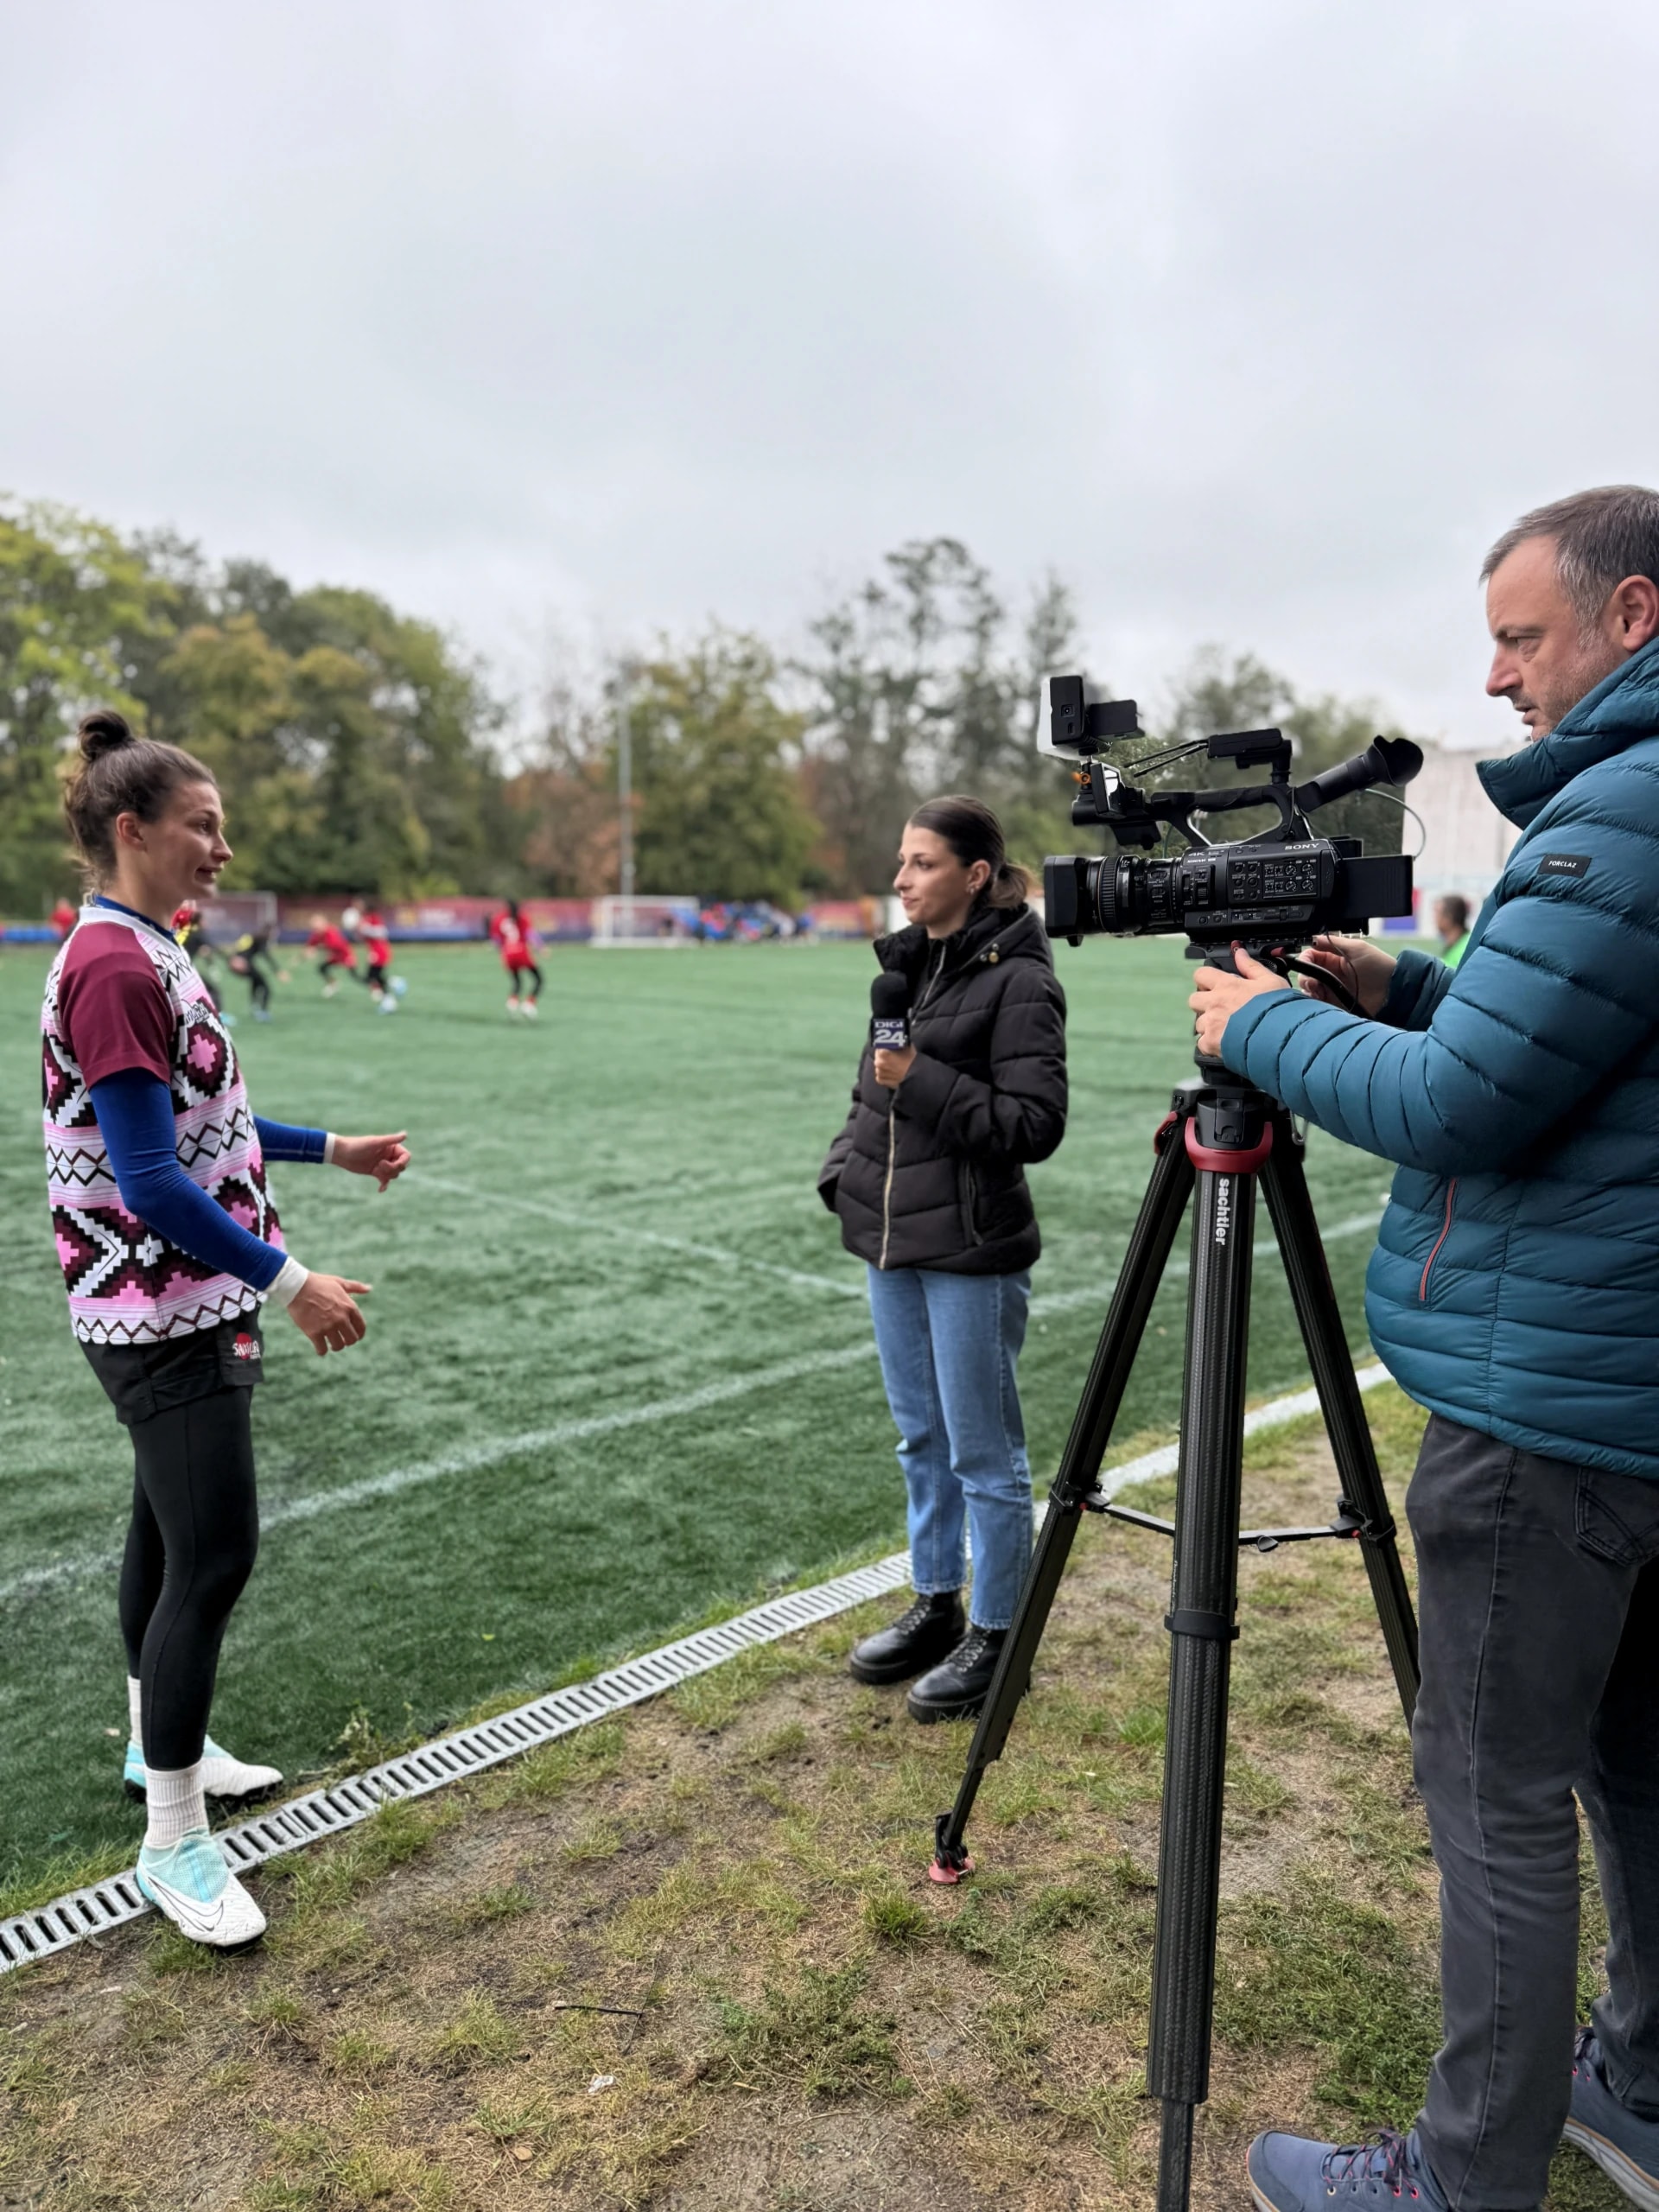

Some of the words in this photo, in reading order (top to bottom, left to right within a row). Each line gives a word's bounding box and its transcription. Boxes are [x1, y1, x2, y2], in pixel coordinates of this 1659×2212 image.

[1548, 860, 1578, 868] FORCLAZ
[873, 1029, 906, 1047] 24
[1215, 1178, 1230, 1245] sachtler
